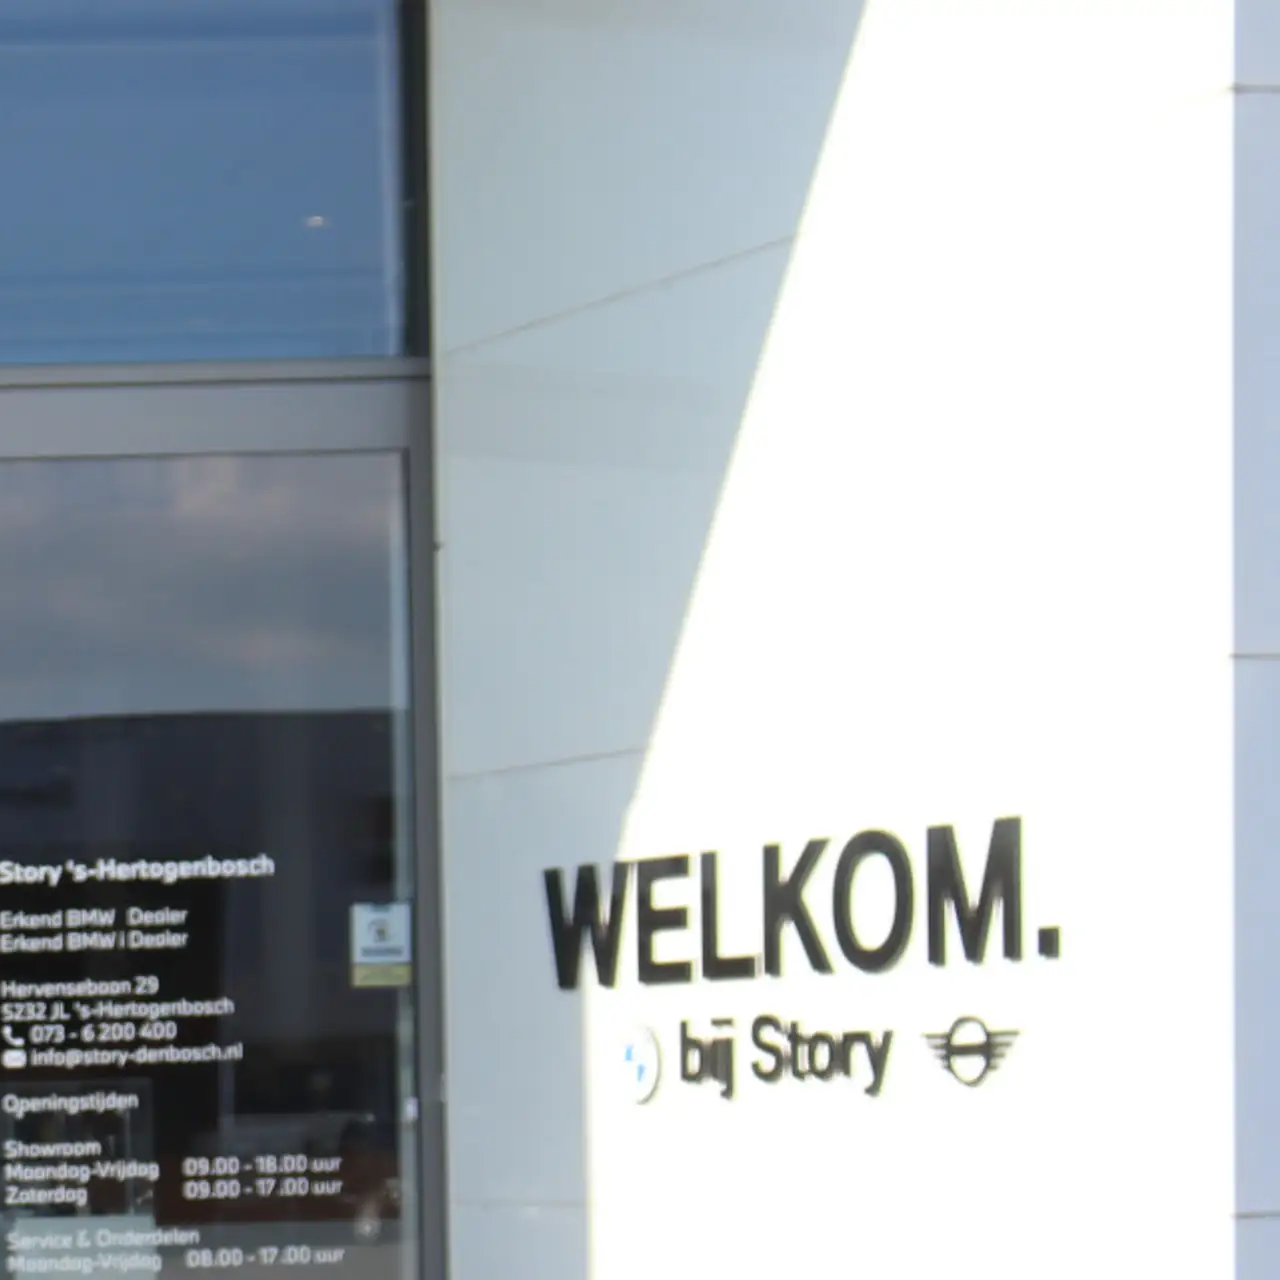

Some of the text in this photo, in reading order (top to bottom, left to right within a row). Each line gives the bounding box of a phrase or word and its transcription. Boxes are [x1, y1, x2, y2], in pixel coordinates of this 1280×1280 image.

[543, 816, 1060, 990] WELKOM.
[66, 908, 116, 928] BMW
[127, 907, 188, 926] Dealer
[67, 932, 116, 951] BMW
[128, 930, 188, 948] Dealer
[1, 976, 159, 998] Hervensebaan 29
[1, 1002, 46, 1021] 5232
[49, 1002, 70, 1020] JL
[30, 1024, 65, 1042] 073
[81, 1023, 94, 1041] 6
[97, 1022, 135, 1041] 200
[139, 1021, 177, 1040] 400
[680, 1014, 893, 1100] bij Story
[2, 1093, 139, 1118] Openingstijden
[5, 1140, 101, 1159] Showroom
[5, 1161, 160, 1183] Maandag-Vrijdag
[183, 1157, 240, 1177] 09.00
[254, 1155, 308, 1175] 18.00
[311, 1157, 342, 1173] uur
[5, 1186, 88, 1207] Zaterdag
[183, 1180, 240, 1200] 09.00
[312, 1180, 342, 1195] uur
[7, 1227, 200, 1252] Service & Onderdelen
[7, 1252, 162, 1275] Maandag-Vrijdag
[315, 1249, 345, 1264] uur
